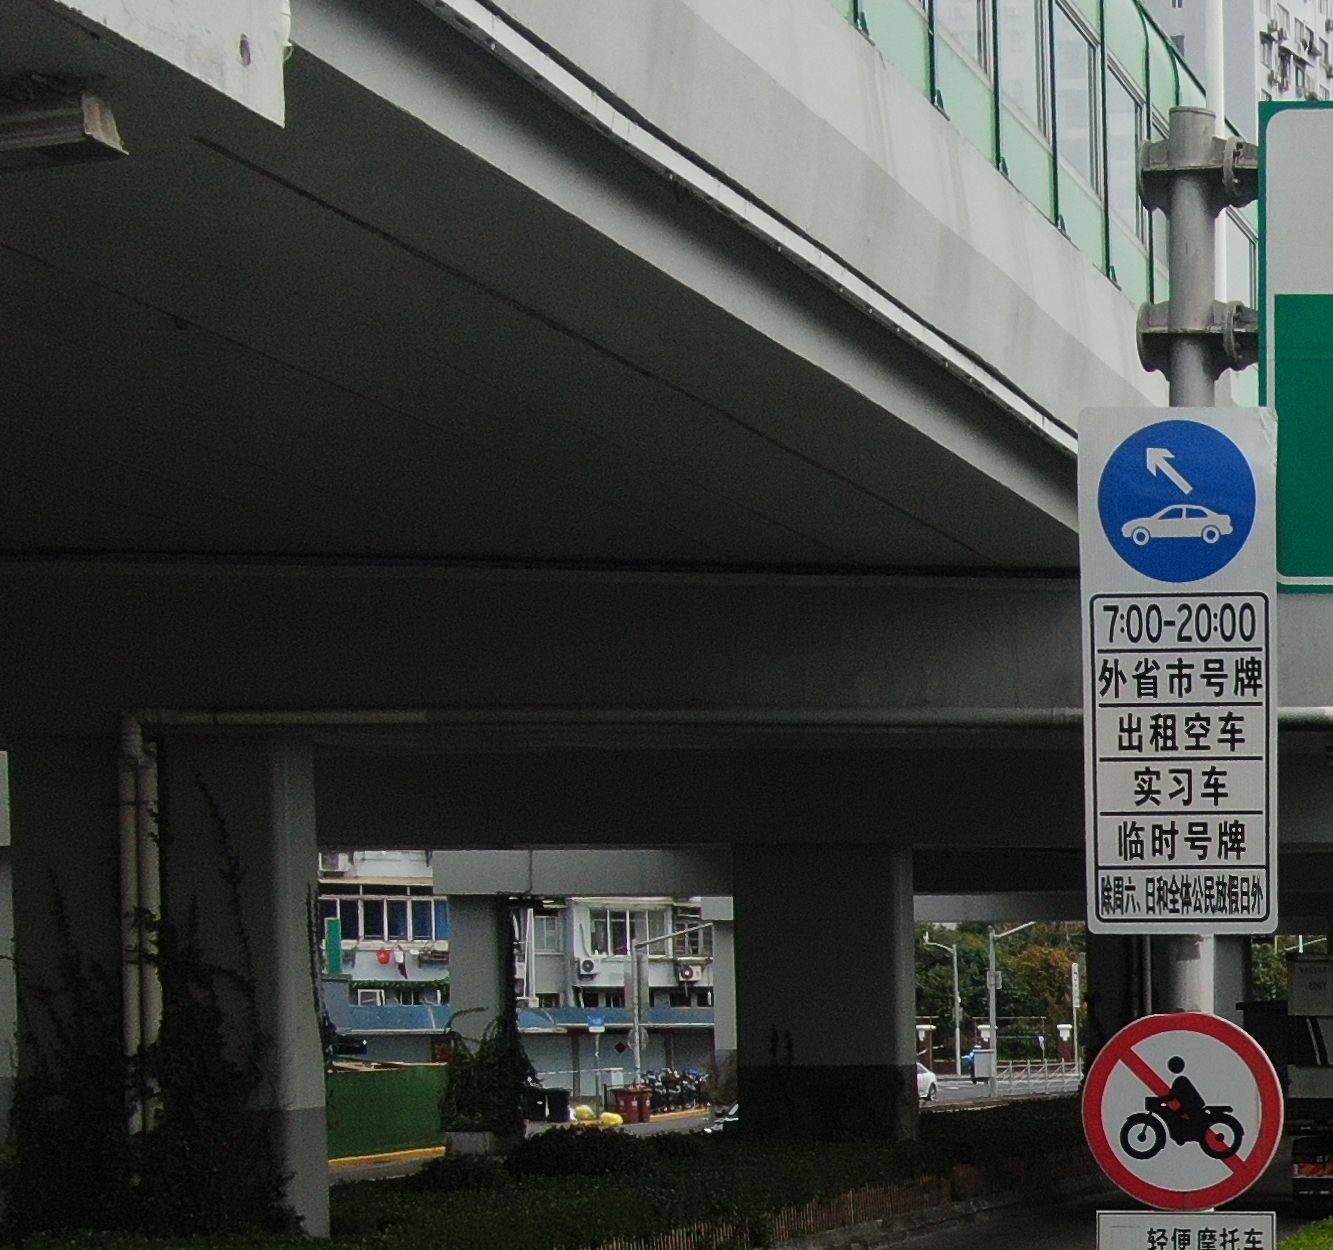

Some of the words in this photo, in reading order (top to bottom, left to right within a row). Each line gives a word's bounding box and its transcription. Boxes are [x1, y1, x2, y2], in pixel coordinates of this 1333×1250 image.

[1102, 603, 1256, 643] 7:00-20:00
[1098, 657, 1264, 699] 外省市号牌
[1117, 711, 1246, 752] 出租空车
[1133, 766, 1229, 807] 实习车
[1118, 820, 1247, 862] 临时号牌
